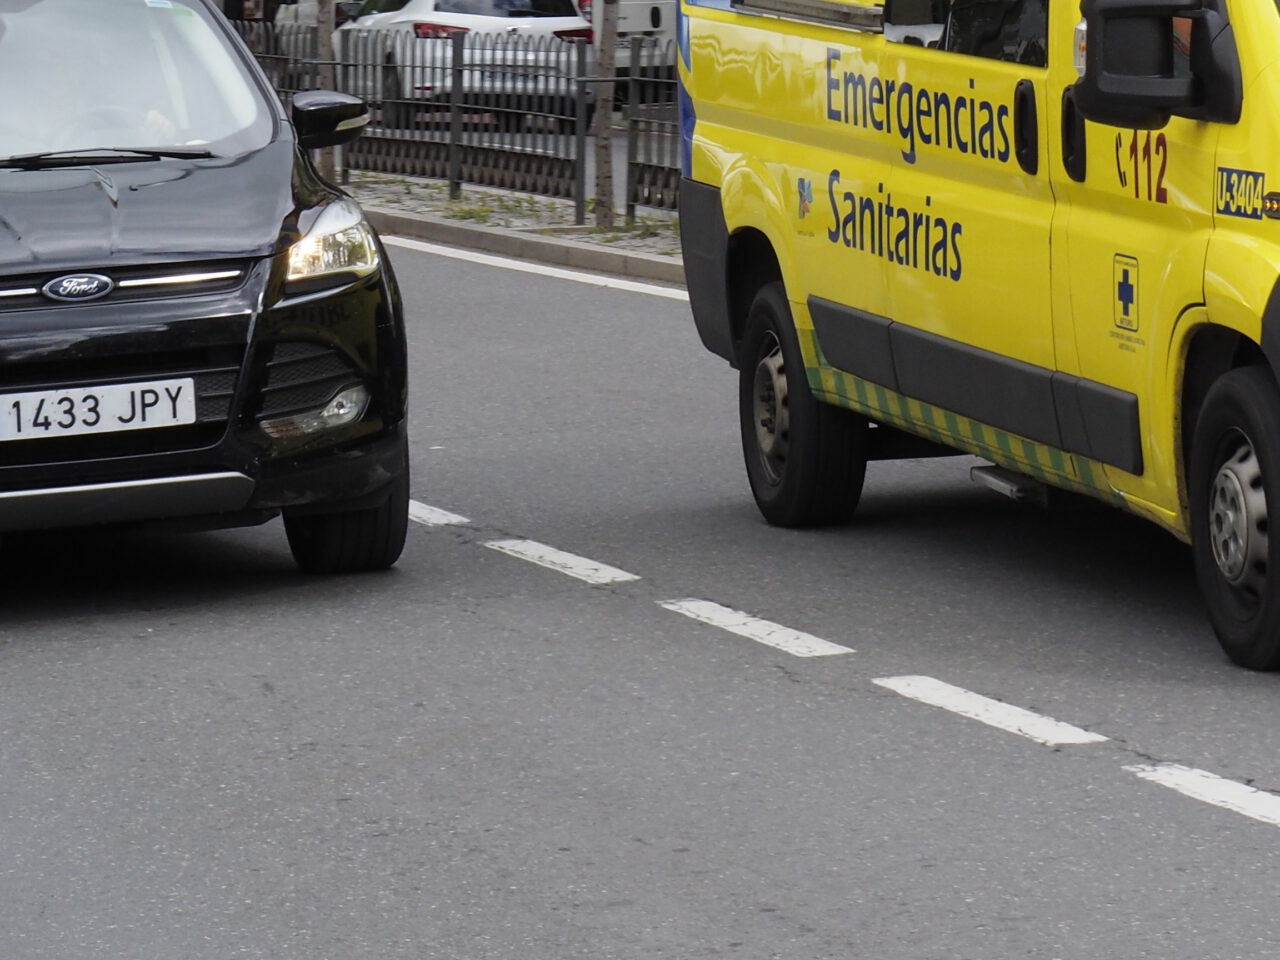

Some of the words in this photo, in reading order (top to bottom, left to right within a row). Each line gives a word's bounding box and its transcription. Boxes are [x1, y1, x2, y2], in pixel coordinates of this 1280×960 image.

[826, 47, 1012, 165] Emergencias
[1129, 129, 1169, 204] 112
[1217, 171, 1263, 216] U-3404
[827, 168, 963, 282] Sanitarias
[59, 277, 99, 296] Ford
[11, 393, 102, 434] 1433
[117, 385, 184, 424] JPY
